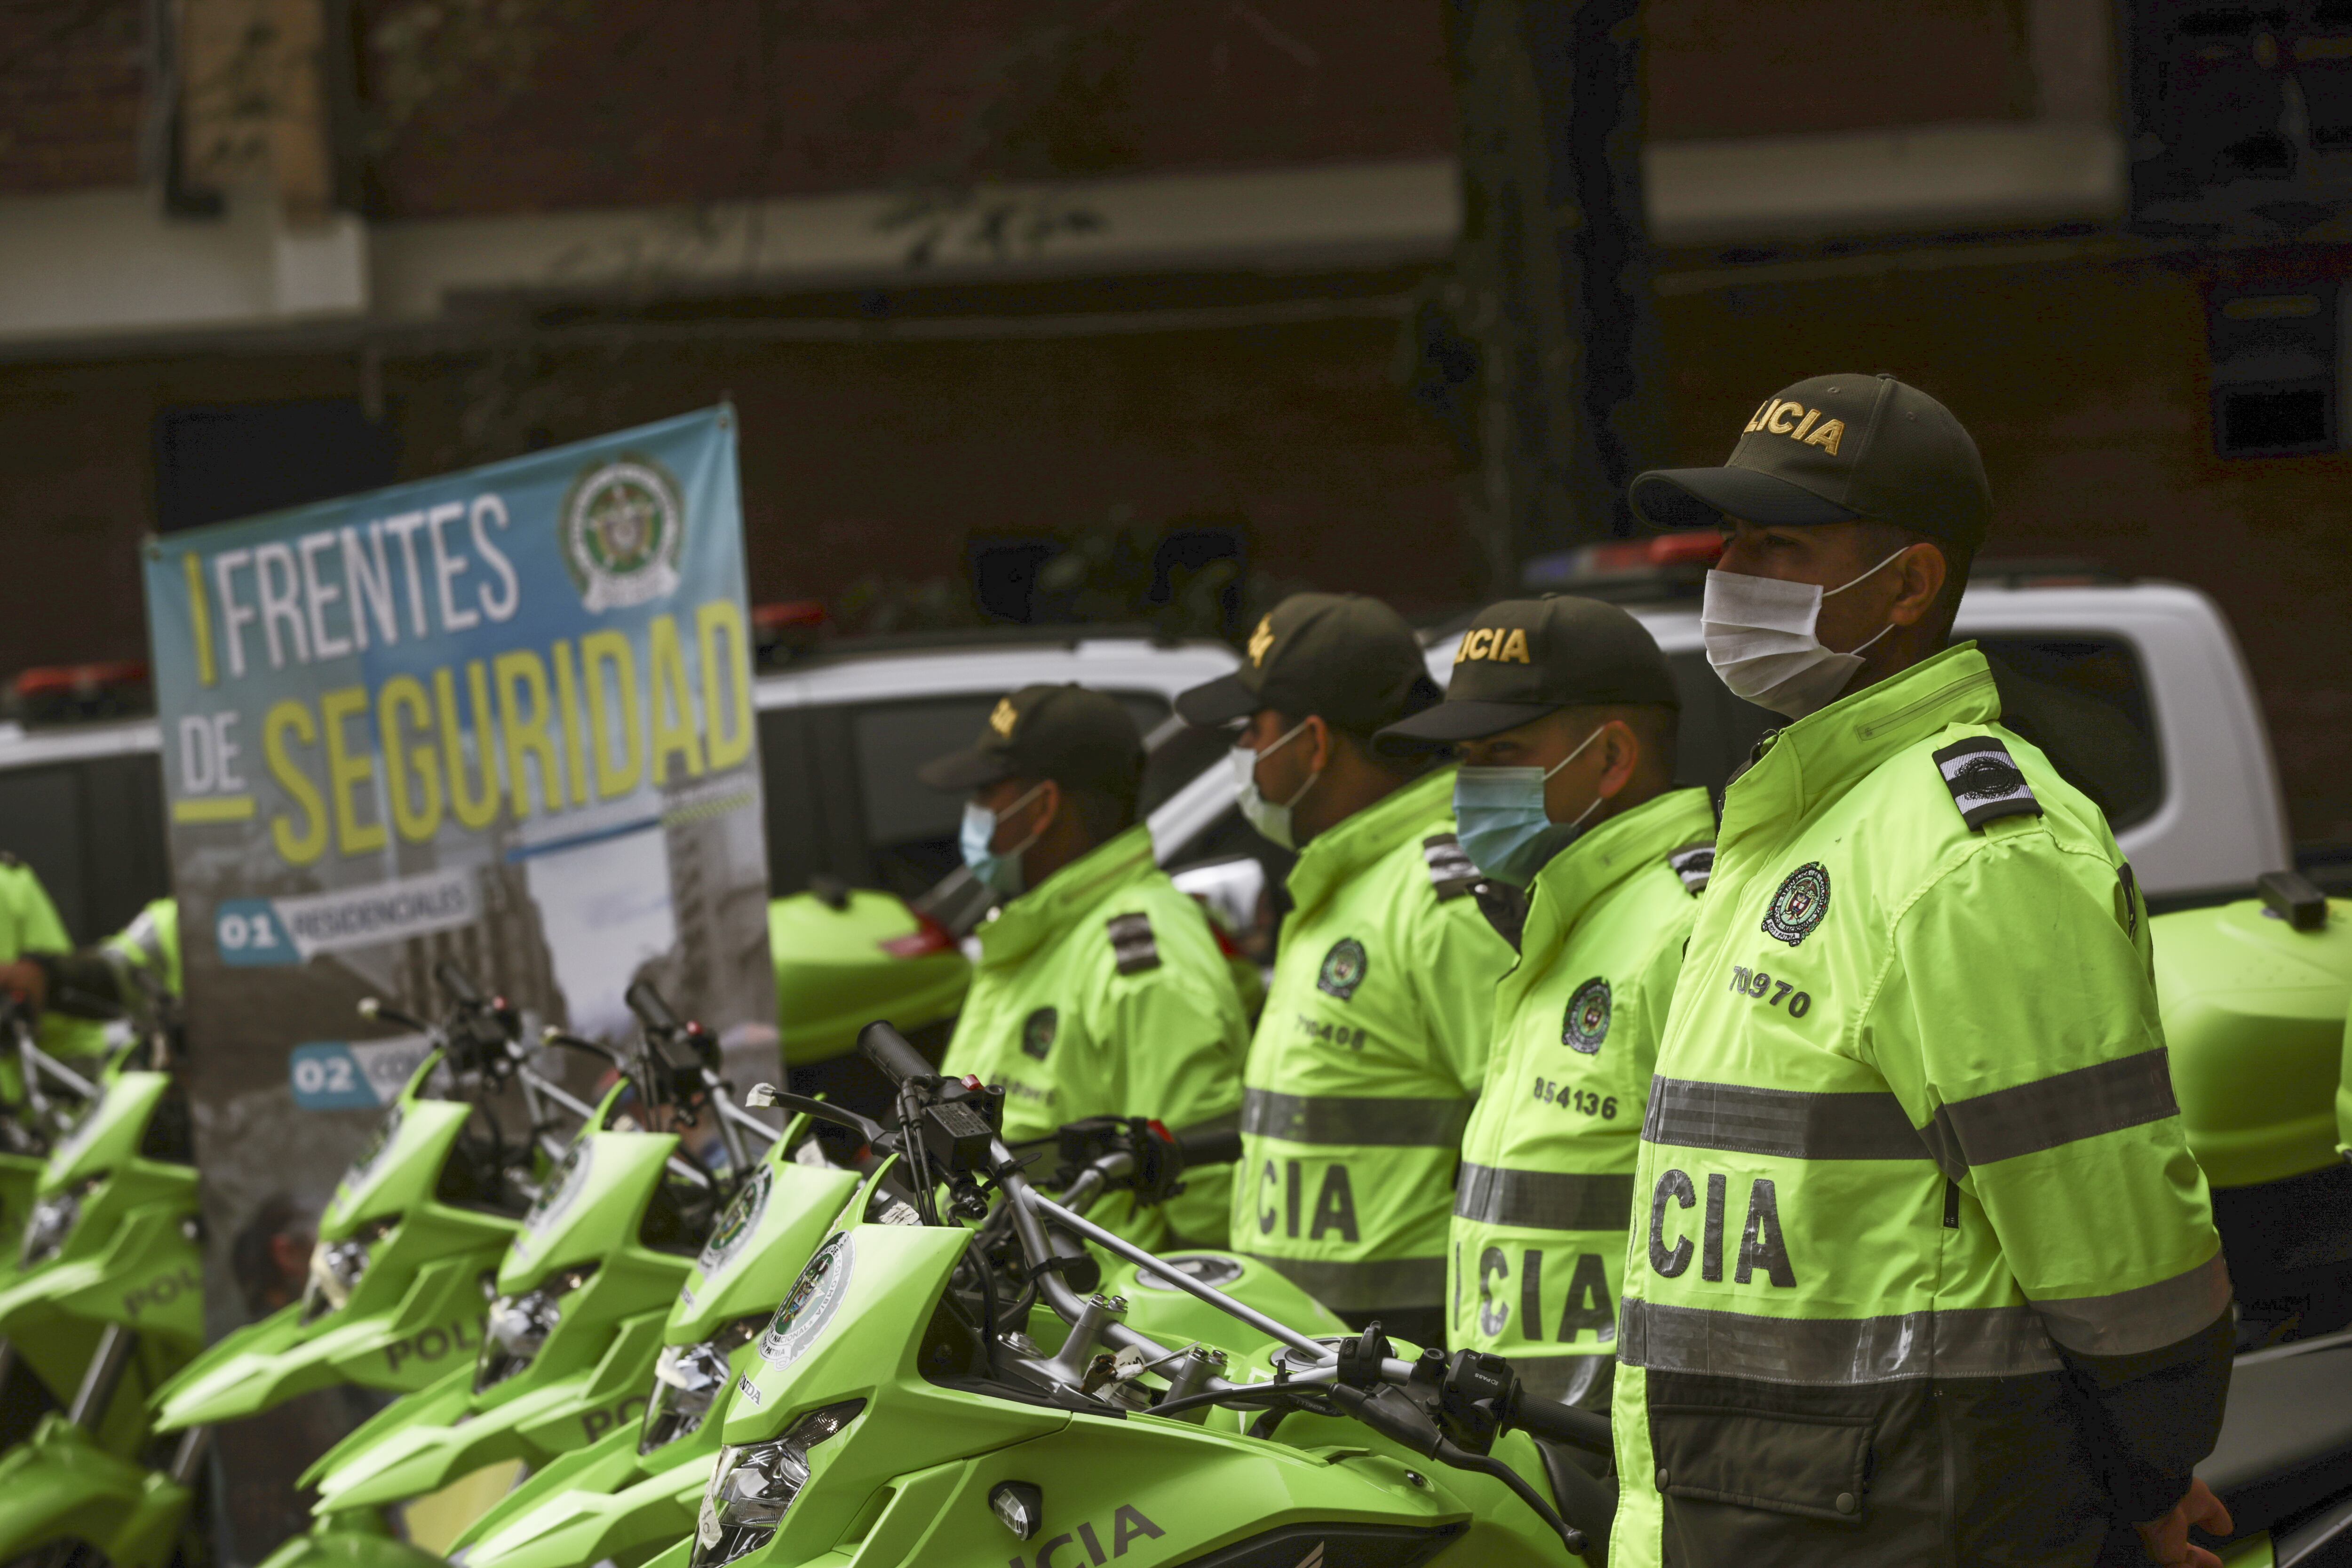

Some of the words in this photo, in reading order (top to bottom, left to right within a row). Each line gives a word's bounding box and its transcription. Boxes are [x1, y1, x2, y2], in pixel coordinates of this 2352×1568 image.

[215, 492, 520, 678] FRENTES
[179, 711, 248, 795] DE
[262, 597, 755, 867] SEGURIDAD
[218, 913, 278, 950] 01
[1729, 965, 1811, 1019] 70970
[295, 1057, 355, 1095] 02
[1534, 1076, 1619, 1121] 854136
[1234, 1158, 1360, 1243] CIA
[1629, 1164, 1797, 1288] CIA
[816, 1260, 841, 1315] COLOMBIA
[765, 1346, 785, 1357] PATRIA
[772, 1325, 809, 1343] NACIONAL
[1474, 1373, 1491, 1383] PASS
[1008, 1504, 1167, 1568] CIA
